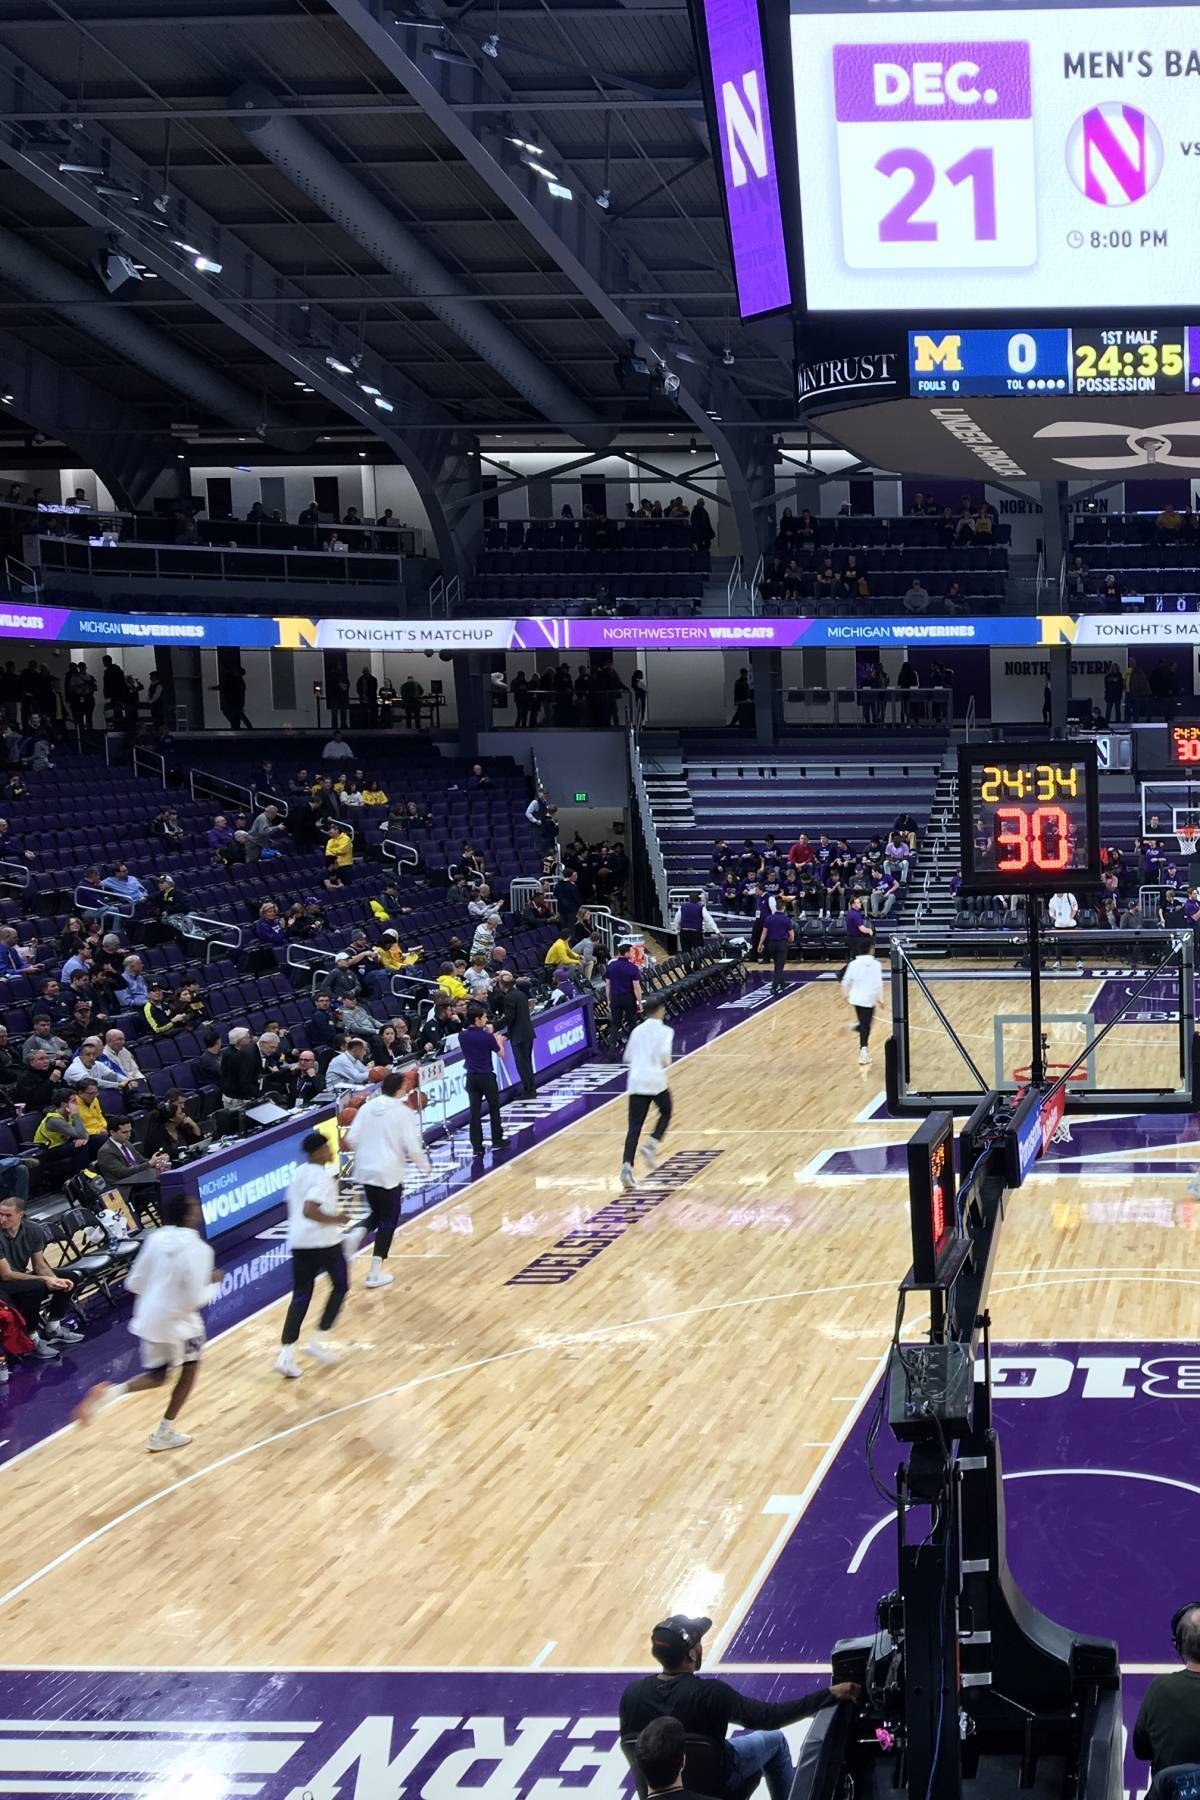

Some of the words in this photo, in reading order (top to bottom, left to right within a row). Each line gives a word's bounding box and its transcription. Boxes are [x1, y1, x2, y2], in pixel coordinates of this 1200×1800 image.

[1063, 51, 1154, 79] MEN'S
[873, 61, 998, 106] DEC.
[874, 146, 997, 244] 21
[1090, 230, 1132, 248] 8:00
[1140, 229, 1168, 247] PM
[1101, 331, 1122, 344] 1ST
[1126, 330, 1158, 344] HALF
[914, 335, 964, 372] M
[1008, 333, 1037, 374] 0
[1075, 344, 1183, 378] 24:35
[919, 380, 946, 392] FOULS
[952, 380, 960, 392] 0
[1007, 380, 1024, 390] TOL
[1077, 377, 1156, 392] POSSESSION
[79, 620, 122, 635] MICHIGAN
[121, 624, 205, 638] WOLVERINES
[336, 627, 416, 642] TONIGHT'S
[420, 628, 494, 642] MATCHUP
[603, 626, 707, 640] NORTHWESTERN
[709, 626, 775, 639] WILDCATS
[827, 625, 890, 638] MICHIGAN
[892, 625, 976, 638] WOLVERINES
[1095, 622, 1172, 636] TONIGHT'S
[1178, 740, 1200, 760] 30
[981, 766, 1077, 802] 24:34
[996, 806, 1072, 871] 30
[547, 1025, 585, 1055] WILDCATS
[199, 1171, 238, 1197] MICHIGAN
[202, 1161, 298, 1225] WOLVERINES
[503, 1189, 676, 1286] WELSH-RYAN
